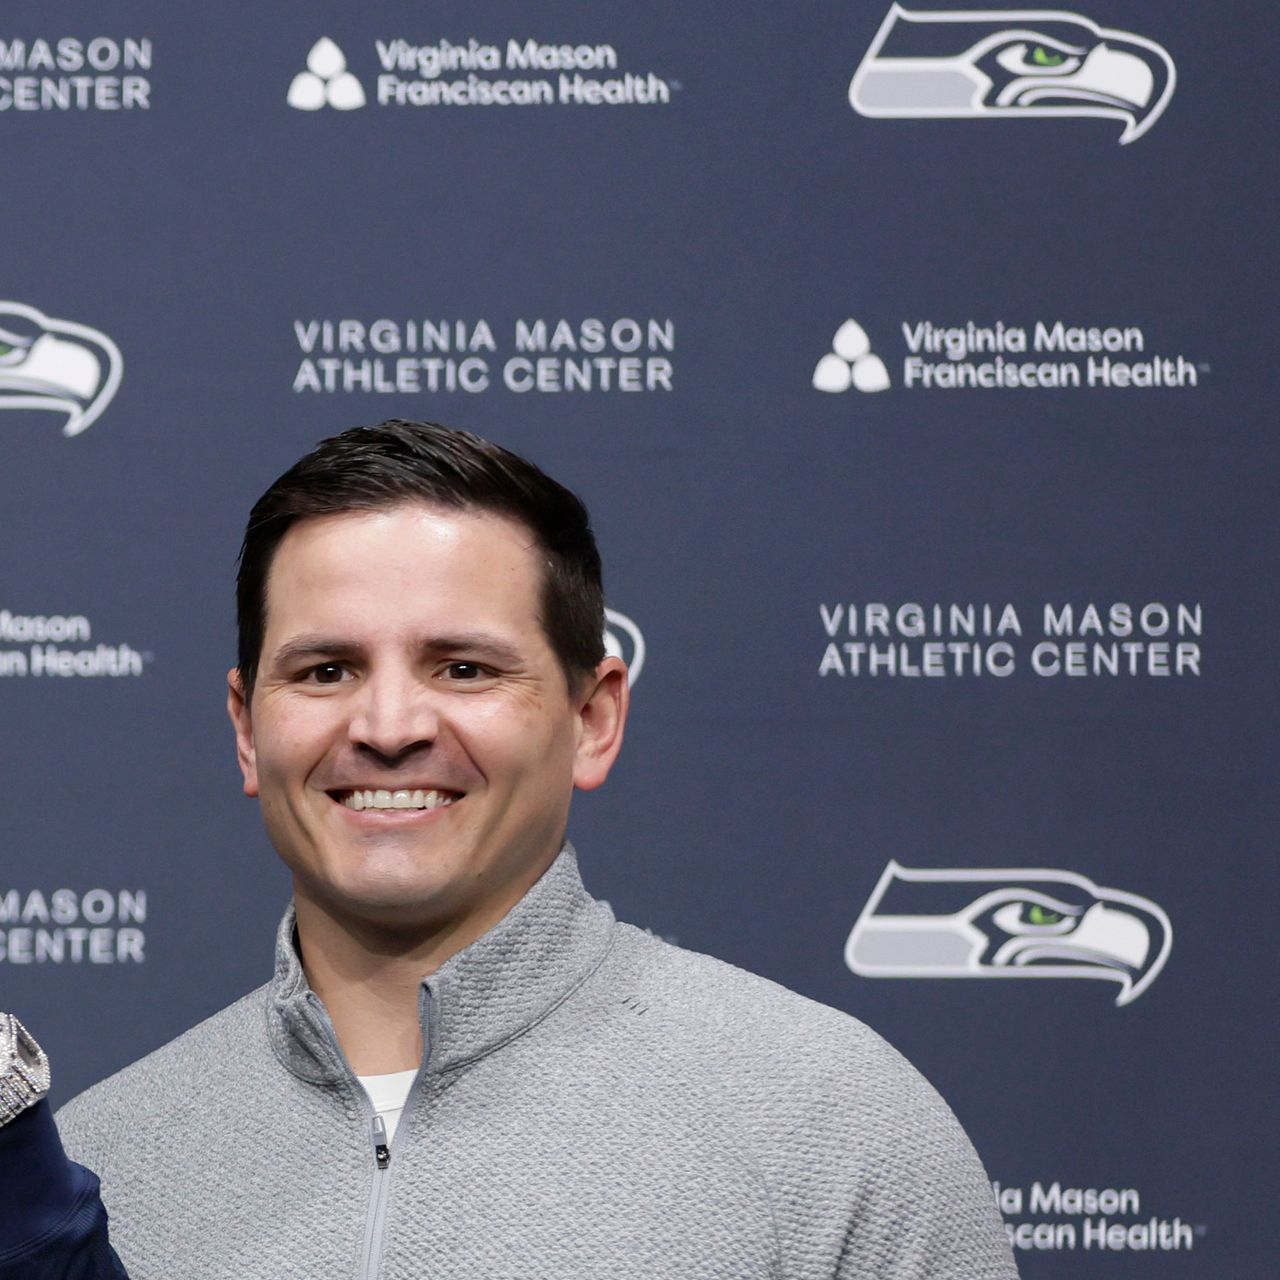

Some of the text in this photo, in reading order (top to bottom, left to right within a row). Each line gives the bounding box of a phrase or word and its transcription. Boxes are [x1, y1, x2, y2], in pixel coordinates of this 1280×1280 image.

[375, 38, 618, 79] Virginia Mason
[377, 72, 670, 106] Franciscan Health
[294, 318, 674, 353] VIRGINIA MASON
[901, 320, 1145, 361] Virginia Mason
[293, 357, 673, 393] ATHLETIC CENTER
[904, 354, 1198, 388] Franciscan Health
[819, 603, 1202, 638] VIRGINIA MASON
[29, 643, 144, 677] Health
[818, 642, 1201, 677] ATHLETIC CENTER
[1029, 1181, 1140, 1215] Mason
[1082, 1216, 1193, 1251] Health
